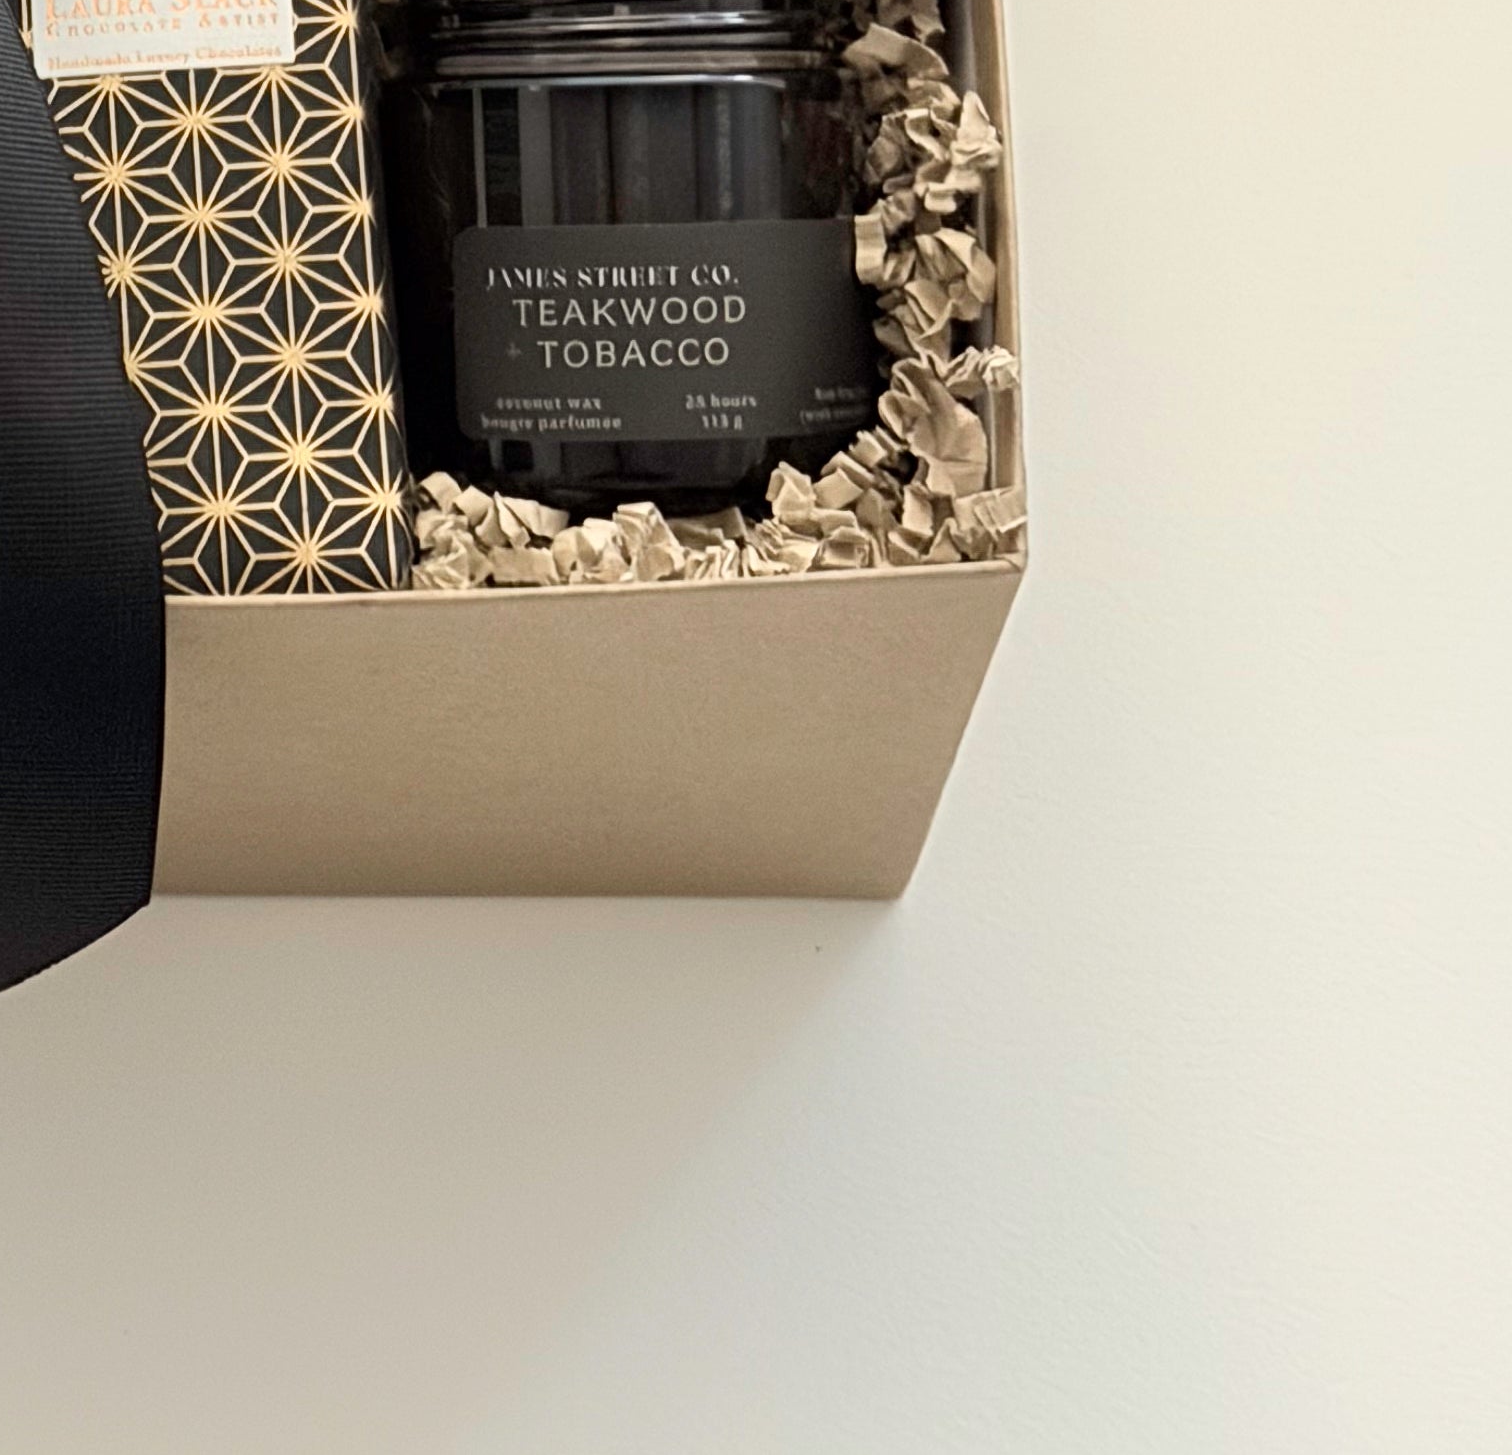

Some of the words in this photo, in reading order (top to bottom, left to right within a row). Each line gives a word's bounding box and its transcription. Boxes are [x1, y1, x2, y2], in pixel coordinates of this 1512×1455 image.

[486, 266, 568, 290] JAMES
[578, 265, 679, 288] STREET
[691, 264, 740, 287] CO.
[512, 295, 746, 328] TEAKWOOD
[536, 337, 729, 369] TOBACCO
[710, 393, 757, 409] hours
